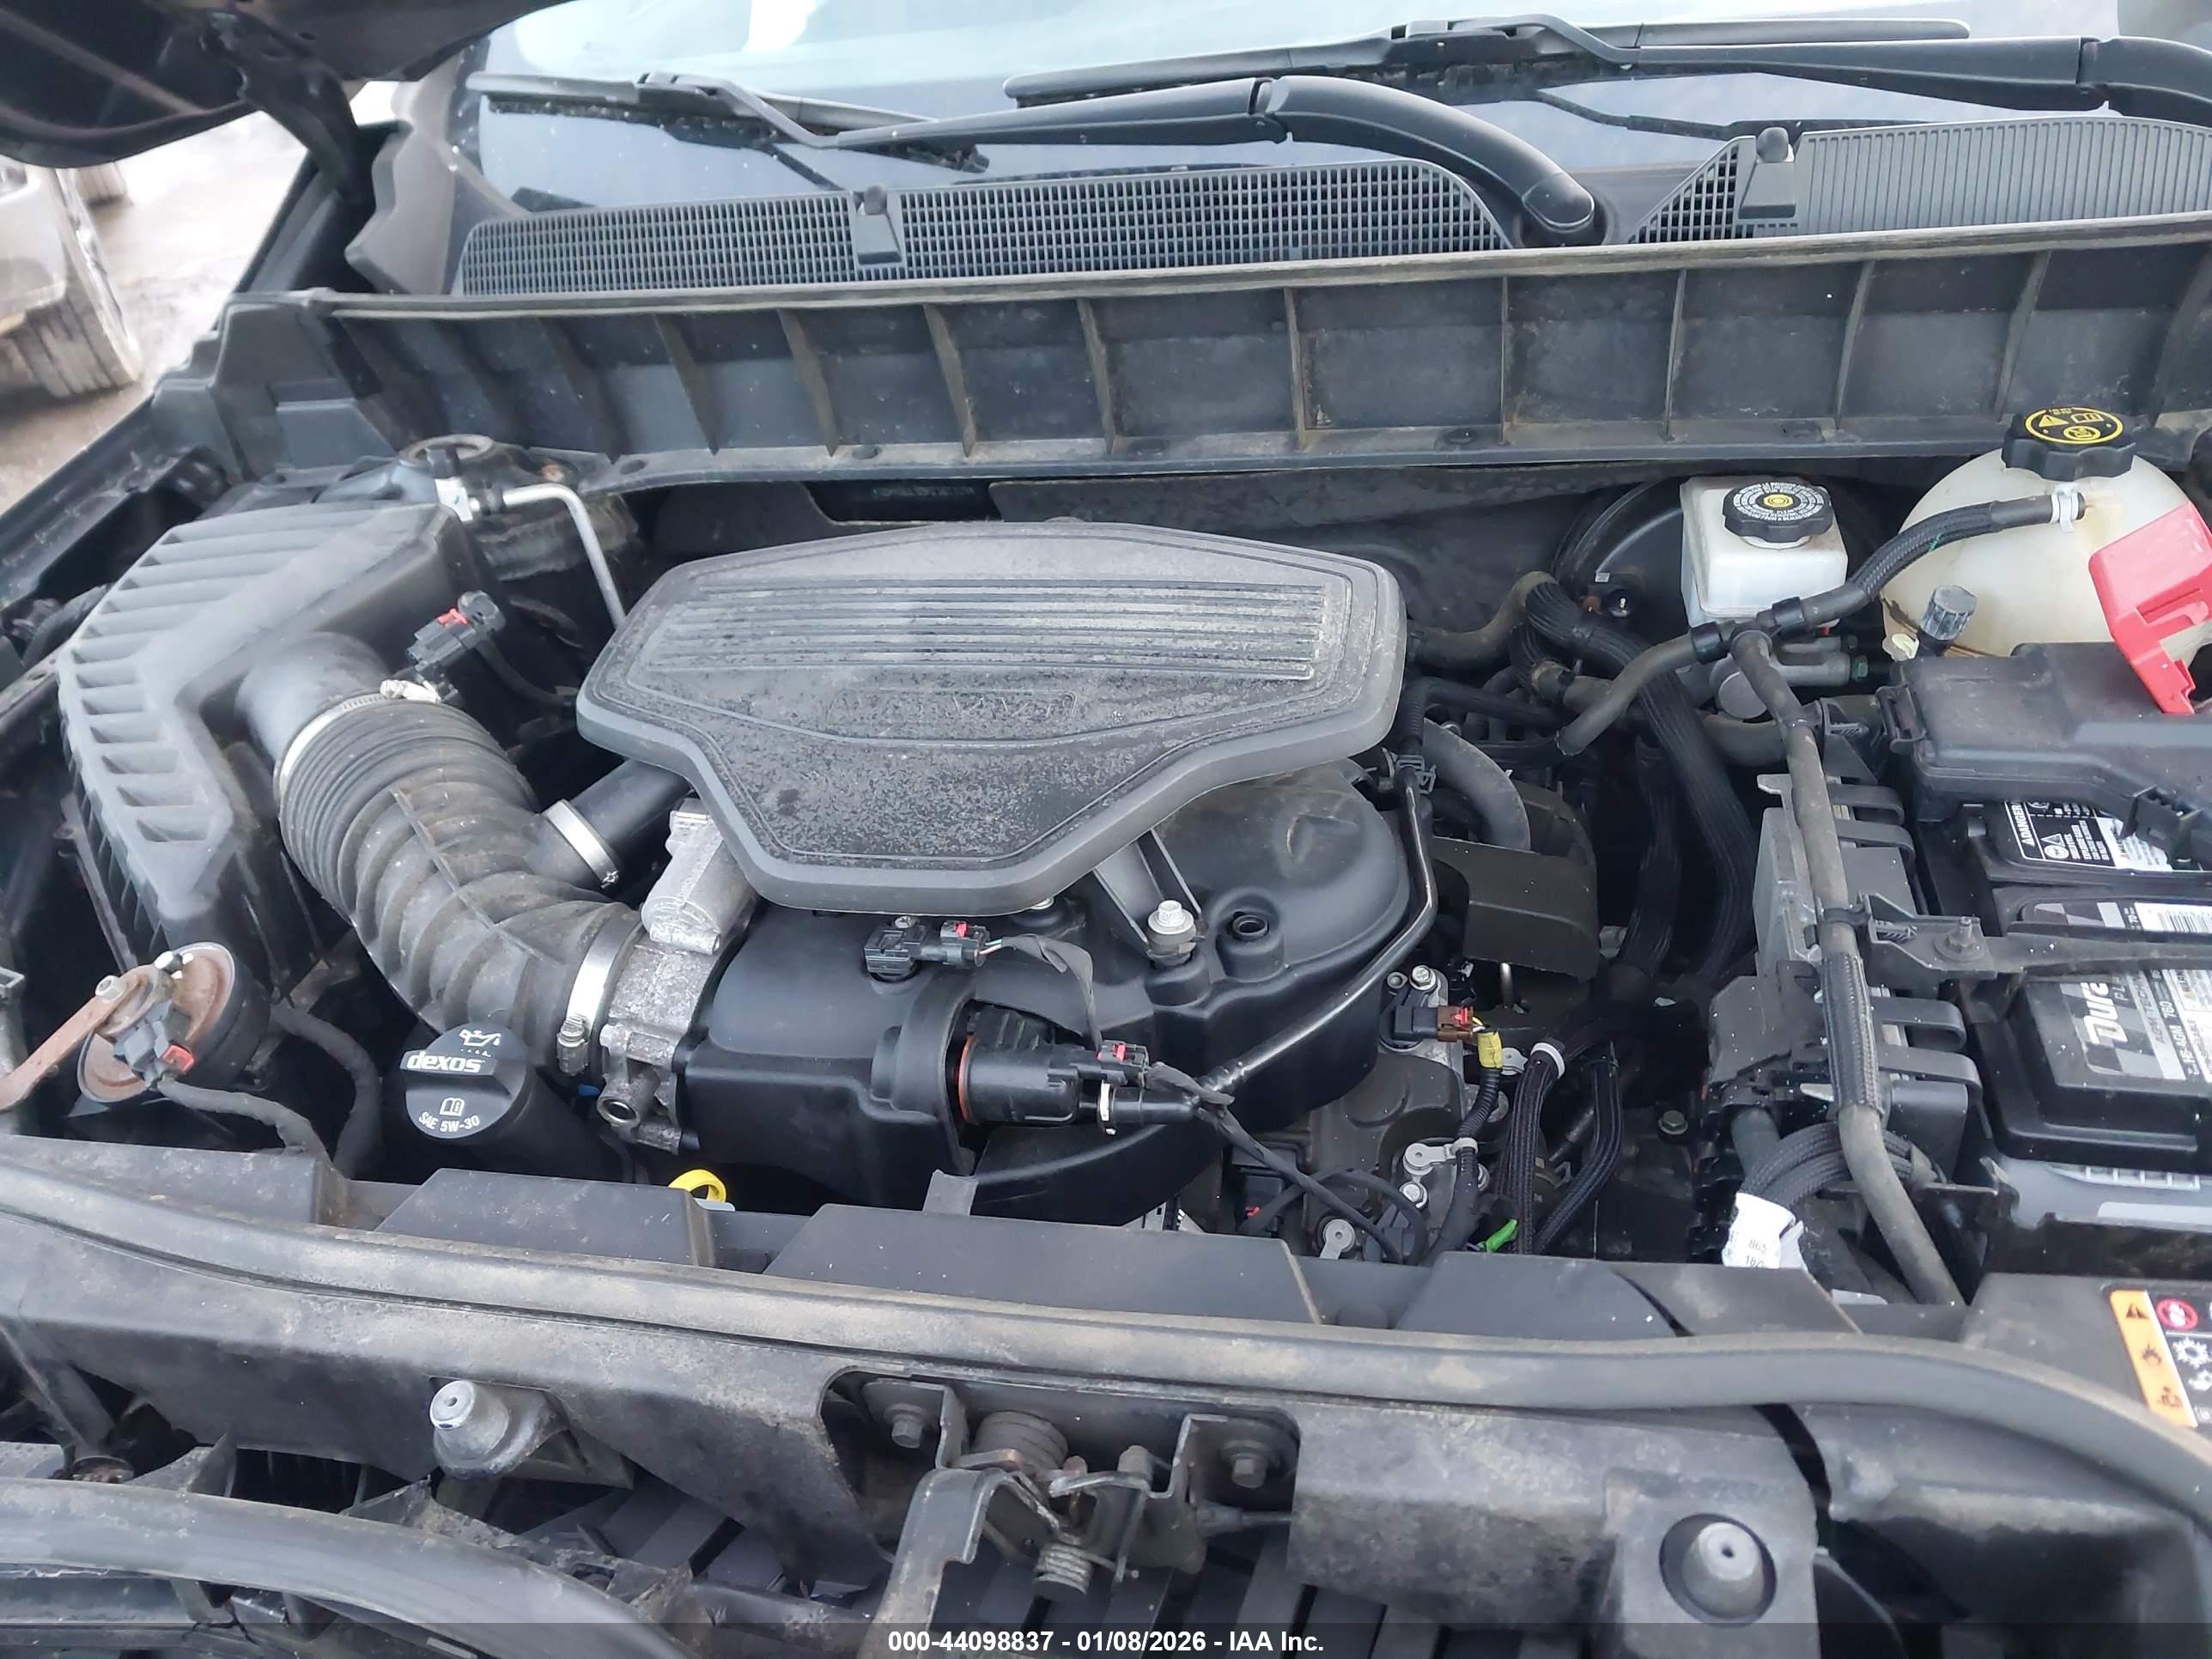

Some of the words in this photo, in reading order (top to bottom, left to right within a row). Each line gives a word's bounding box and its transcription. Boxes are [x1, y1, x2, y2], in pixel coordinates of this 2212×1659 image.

[2160, 1000, 2178, 1018] 760
[406, 1052, 482, 1073] dexos
[418, 1111, 441, 1130] SAE
[440, 1115, 481, 1133] 5W-30
